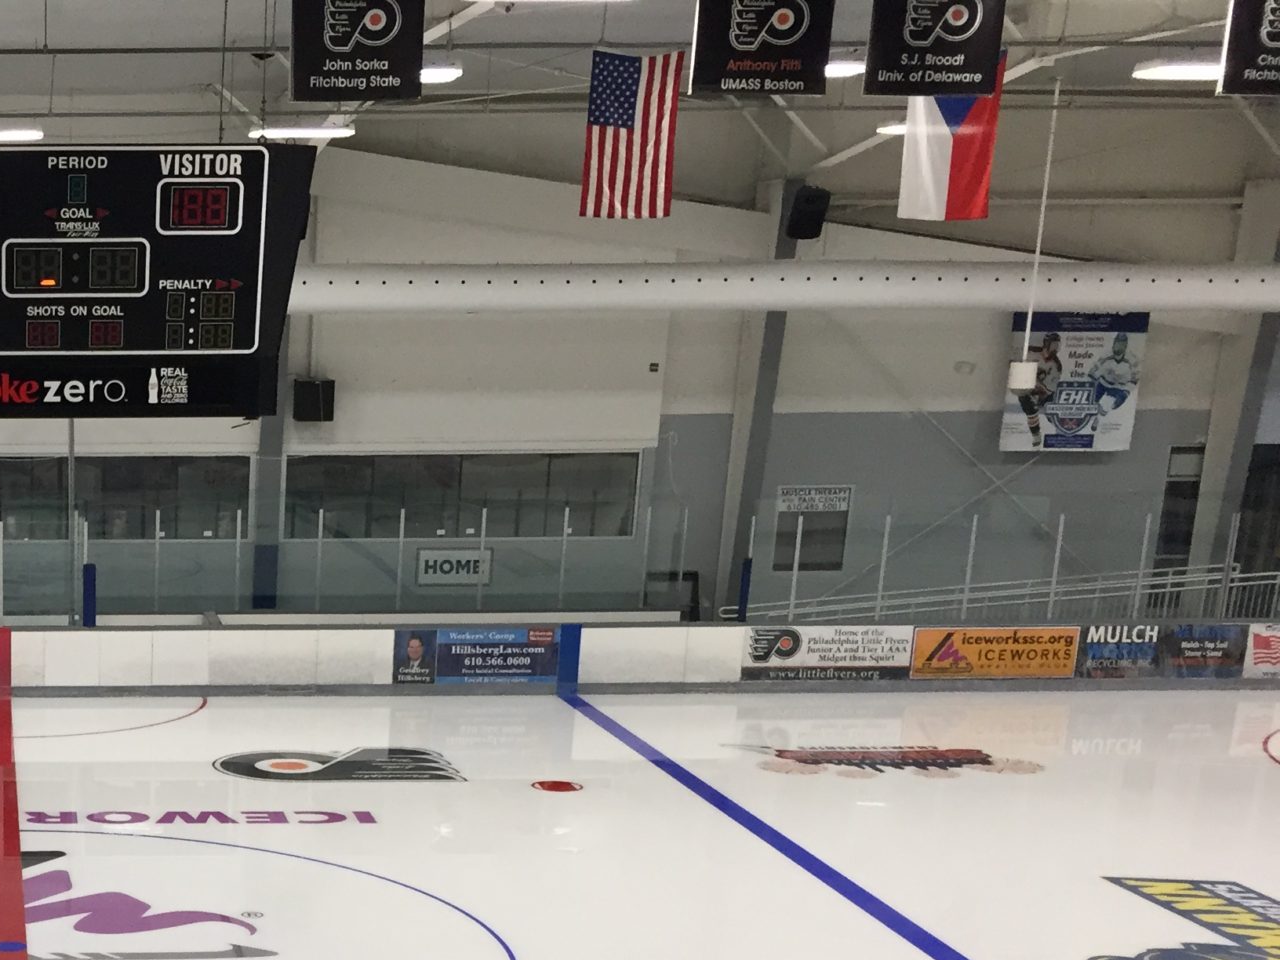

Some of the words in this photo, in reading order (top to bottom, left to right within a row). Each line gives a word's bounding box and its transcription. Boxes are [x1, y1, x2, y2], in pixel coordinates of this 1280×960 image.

[323, 59, 352, 71] John
[355, 59, 388, 71] Sorka
[726, 60, 778, 72] Anthony
[925, 54, 965, 66] Broadt
[878, 70, 905, 82] Univ.
[909, 70, 922, 82] of
[925, 71, 982, 82] Delaware
[310, 76, 366, 90] Fitchburg
[369, 75, 401, 87] State
[721, 78, 761, 90] UMASS
[764, 79, 804, 90] Boston
[48, 156, 108, 169] PERIOD
[160, 154, 242, 176] VISITOR
[60, 208, 93, 218] GOAL
[159, 280, 212, 290] PENALTY
[26, 306, 65, 317] SHOTS
[71, 306, 87, 317] ON
[92, 306, 124, 317] GOAL
[1068, 351, 1094, 359] Made
[160, 368, 188, 377] REAL
[43, 380, 126, 402] zero
[1059, 390, 1090, 405] EHL
[424, 559, 485, 575] HOME
[961, 631, 1074, 646] iceworkssc.org
[1086, 625, 1159, 643] MULCH
[807, 637, 859, 645] Philadelphia
[861, 637, 882, 645] Little
[884, 637, 909, 646] Flyers
[451, 645, 545, 655] HillsbergLaw.com
[807, 646, 833, 654] Junior
[977, 649, 1072, 661] ICEWORKS
[464, 657, 531, 666] 610.566.0600
[818, 654, 847, 663] Midget
[868, 654, 895, 663] Squirt
[769, 669, 880, 679] www.littleflyers.org
